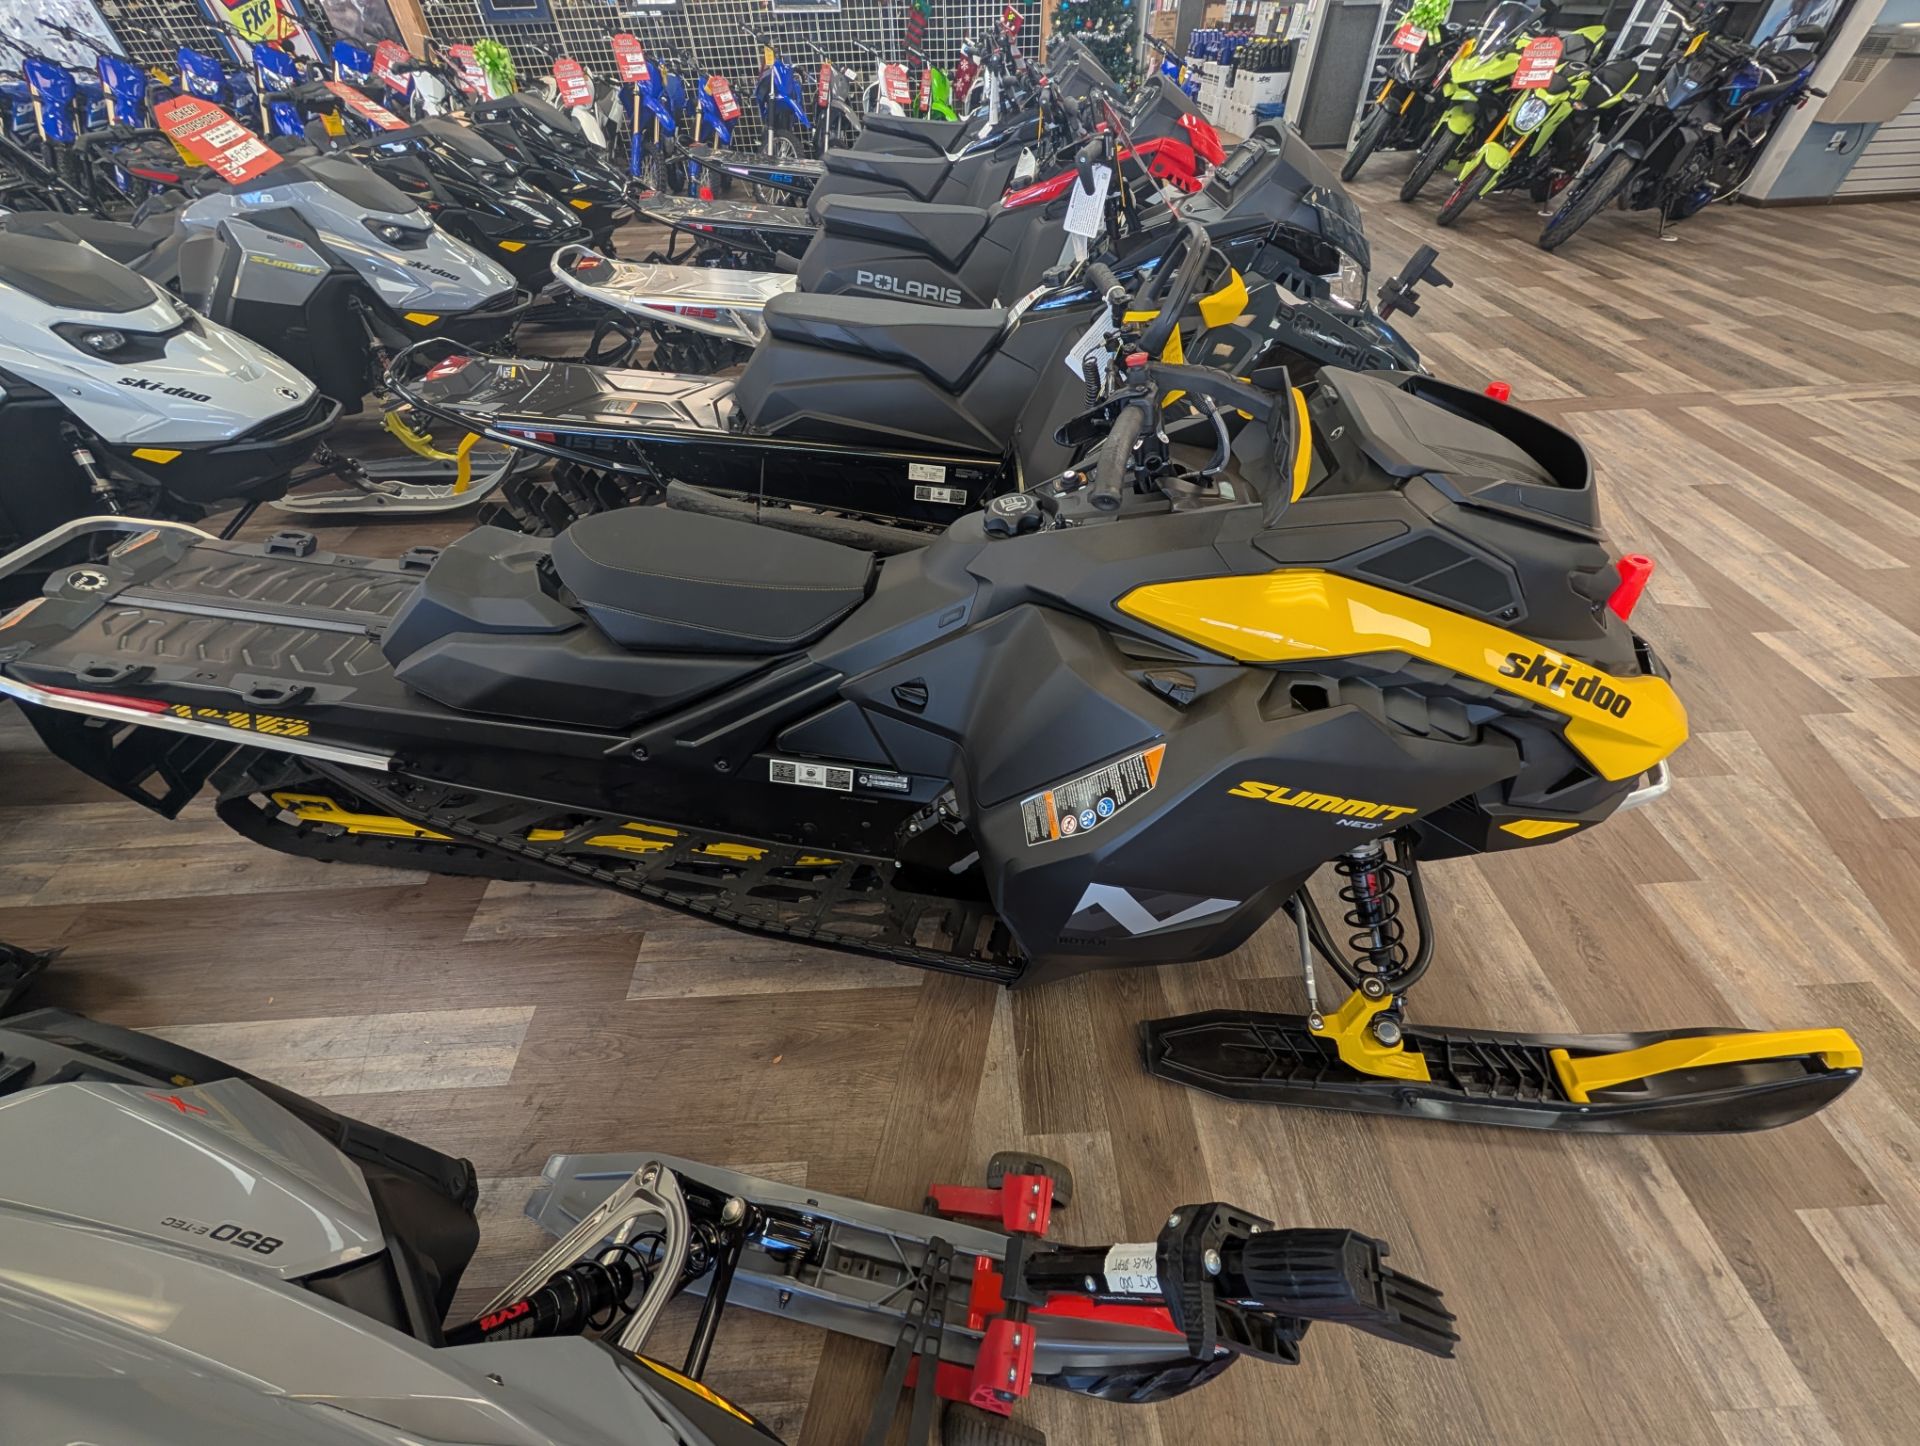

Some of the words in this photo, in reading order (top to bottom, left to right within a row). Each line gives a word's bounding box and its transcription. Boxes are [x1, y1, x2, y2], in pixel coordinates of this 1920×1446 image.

[242, 0, 272, 37] FXR
[166, 103, 199, 121] VICKERY
[169, 111, 224, 137] MOTORSPORTS
[406, 260, 460, 281] ski-doo
[856, 270, 962, 304] POLARIS
[117, 378, 211, 402] ski-doo
[1498, 652, 1632, 719] ski-doo
[1227, 781, 1418, 820] SUMMIT
[161, 1217, 209, 1235] E-TEC
[209, 1224, 284, 1254] 850
